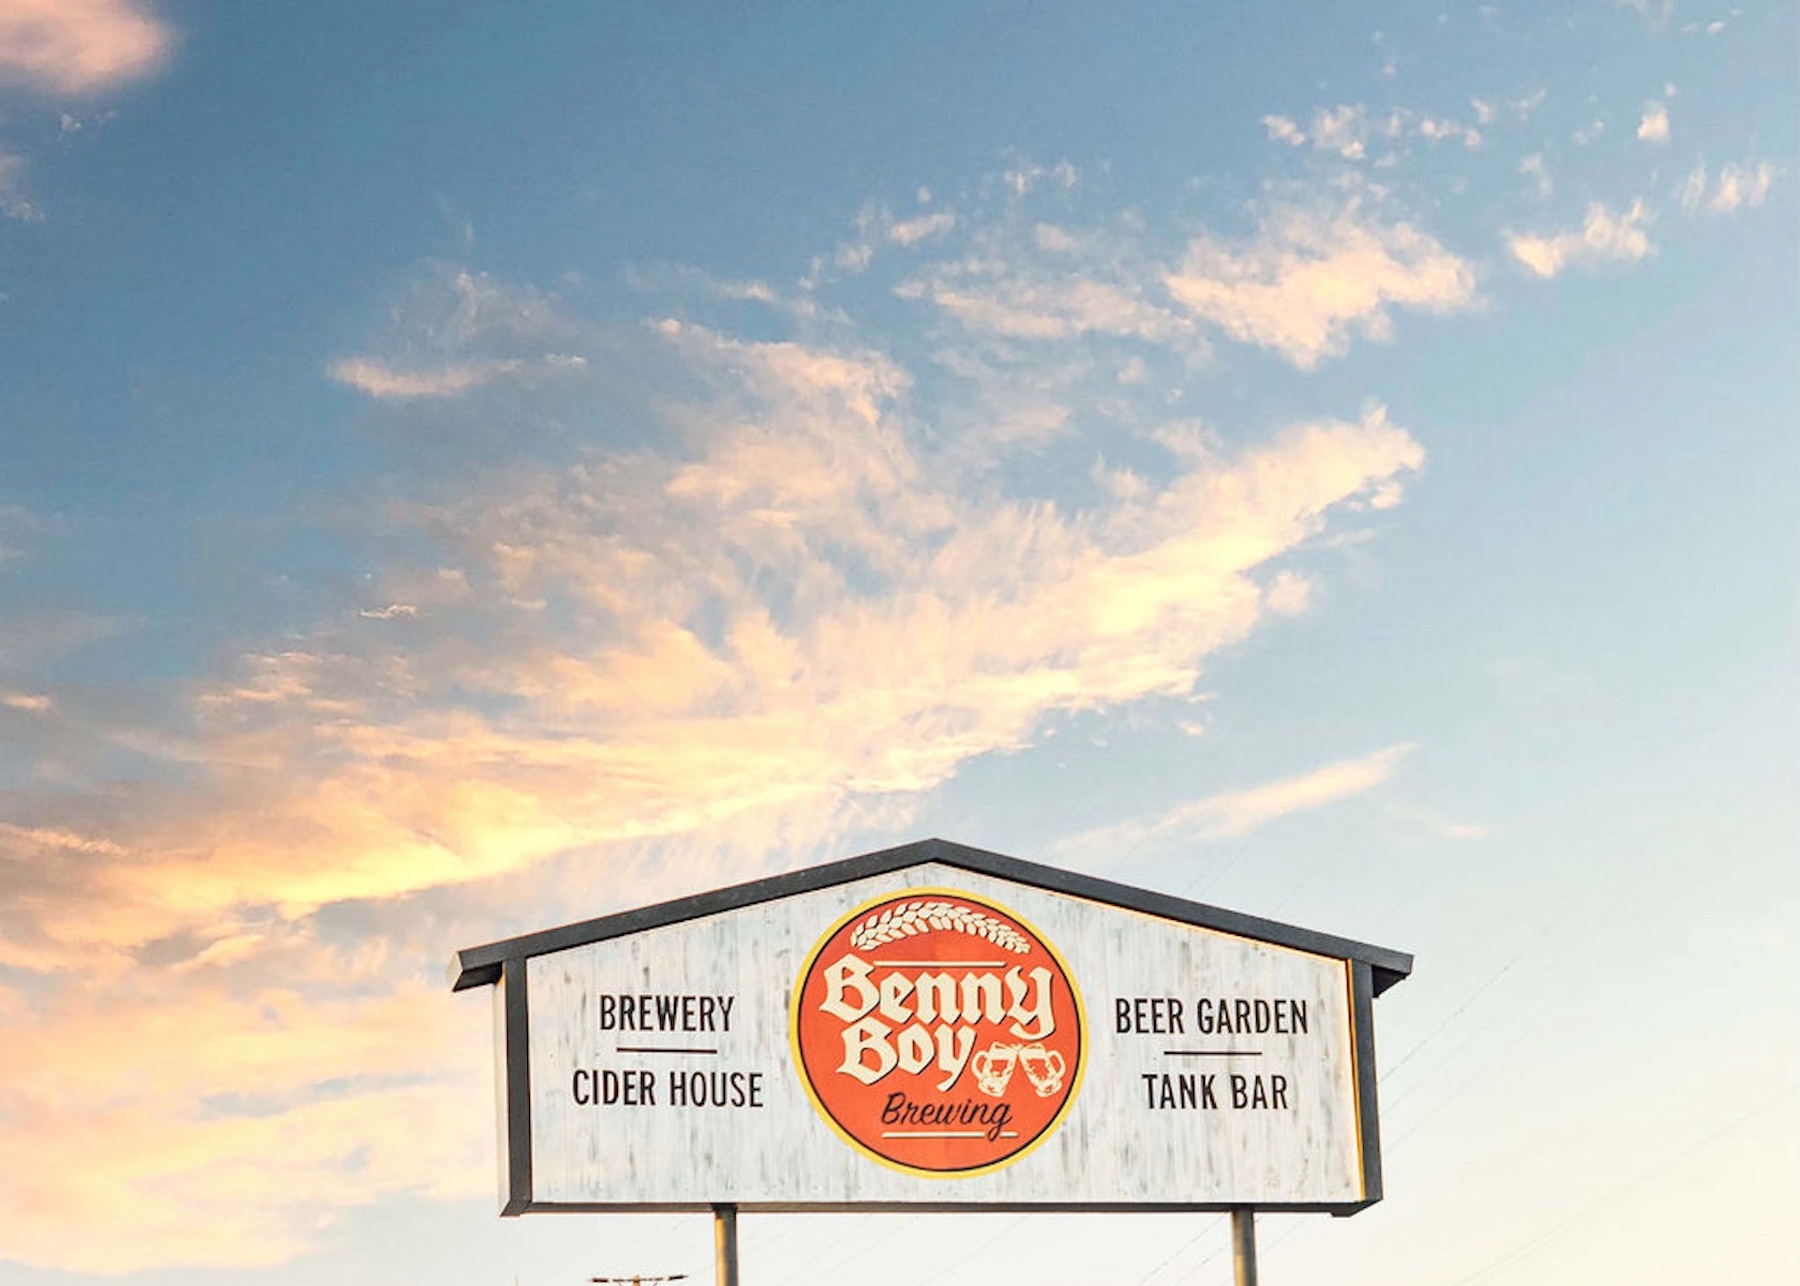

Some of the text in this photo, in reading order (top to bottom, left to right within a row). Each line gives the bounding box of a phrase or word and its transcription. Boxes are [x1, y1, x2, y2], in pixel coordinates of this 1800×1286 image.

[599, 994, 735, 1032] BREWERY
[818, 953, 1057, 1042] Benny
[1115, 997, 1308, 1035] BEER GARDEN
[836, 1016, 978, 1093] Boy
[572, 1069, 764, 1108] CIDER HOUSE
[1141, 1073, 1288, 1110] TANK BAR
[880, 1091, 1013, 1142] Brewing
